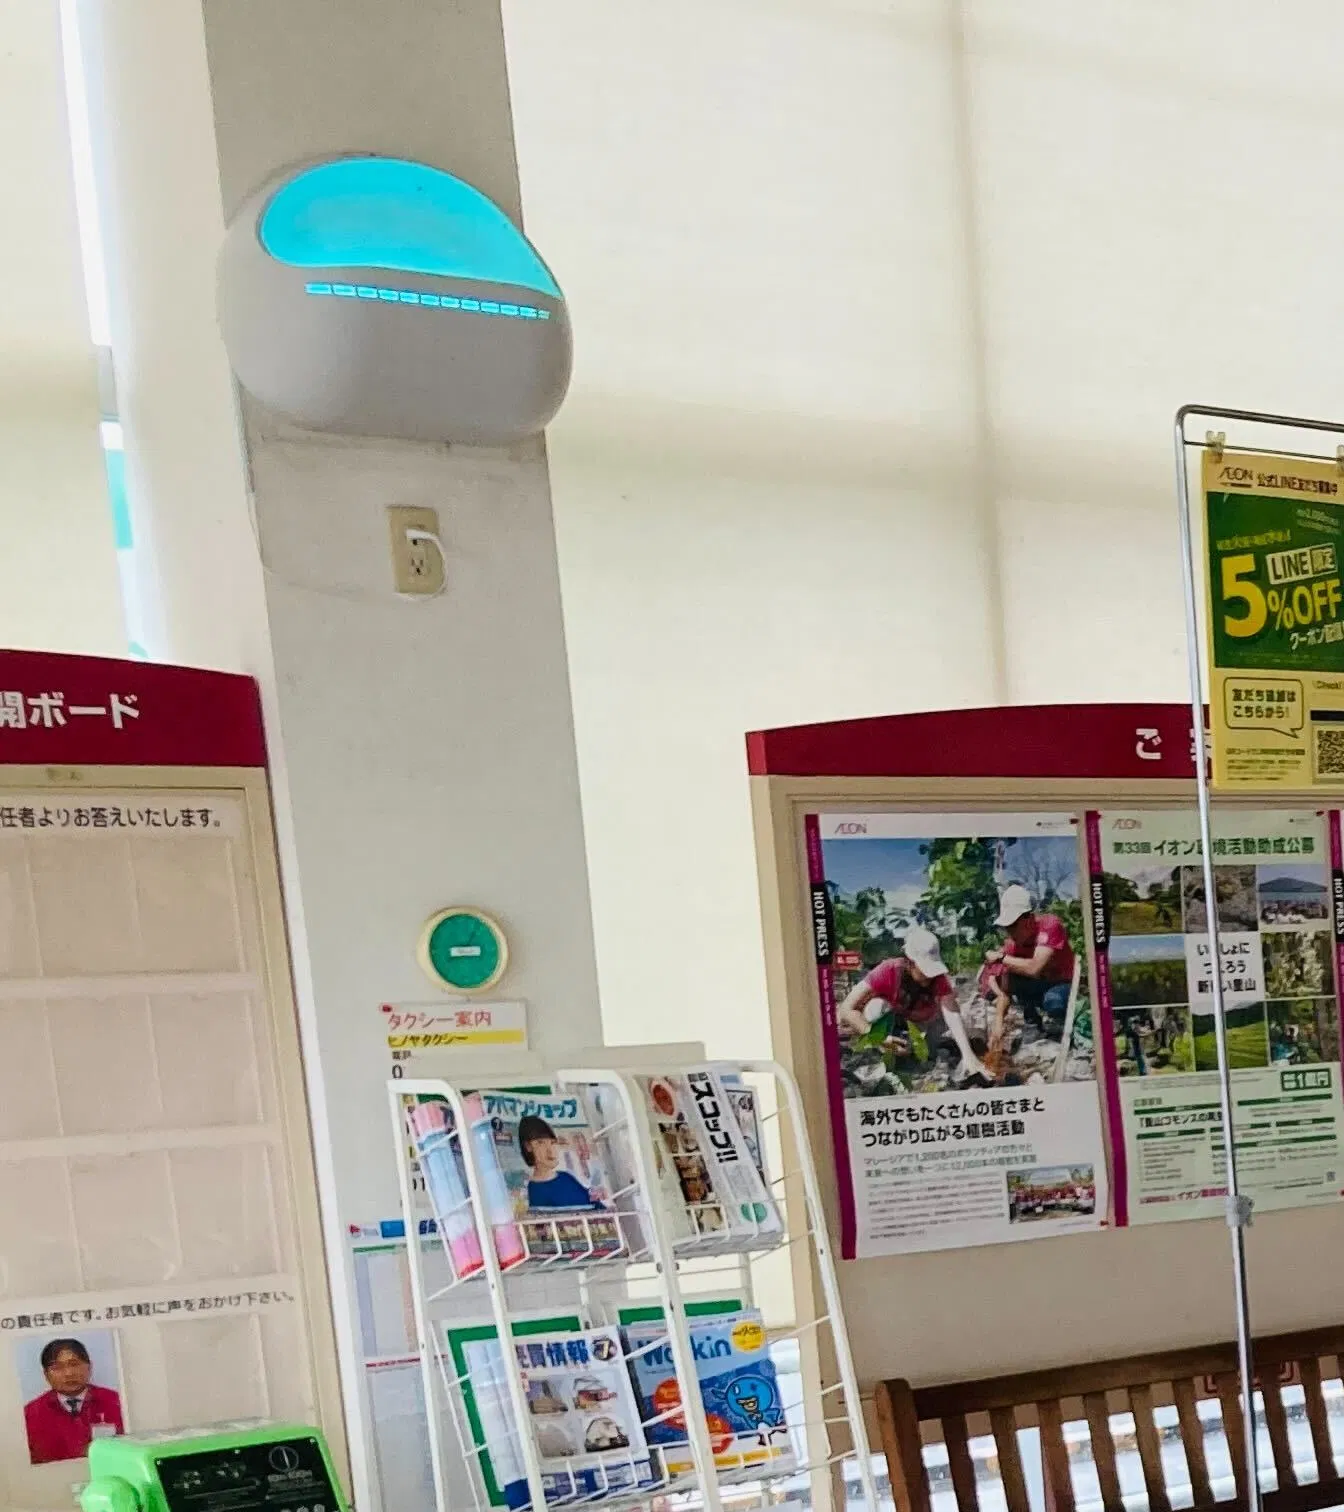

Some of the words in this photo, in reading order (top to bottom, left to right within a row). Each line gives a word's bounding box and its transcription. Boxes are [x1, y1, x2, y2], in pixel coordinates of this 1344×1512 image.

[0, 807, 221, 828] 任者よりお答えいたします。
[1091, 882, 1104, 907] HOT
[1334, 877, 1344, 900] HOT
[812, 891, 826, 918] HOT
[814, 919, 830, 957] PRESS
[1094, 908, 1108, 944] PRESS
[1196, 942, 1251, 955] いしょに
[388, 1010, 493, 1030] タクシー案内
[860, 1097, 1045, 1126] 海外でもたくさんの皆さまと
[862, 1120, 1025, 1147] つながり広がる植樹活動
[637, 1335, 732, 1367] Wokin
